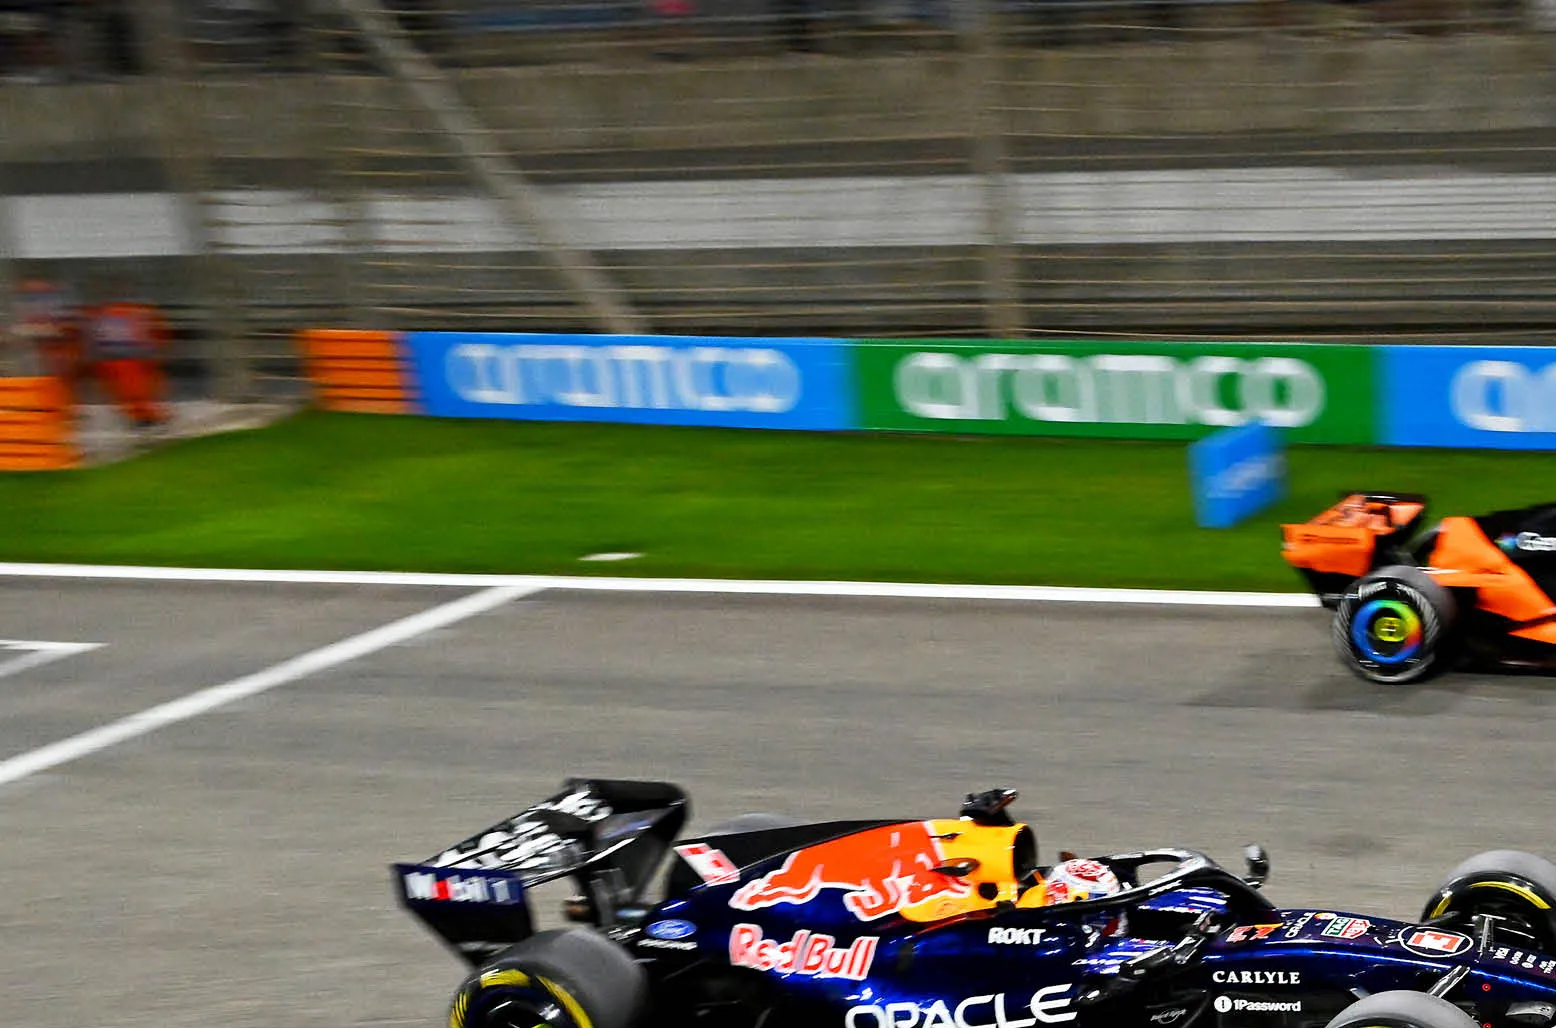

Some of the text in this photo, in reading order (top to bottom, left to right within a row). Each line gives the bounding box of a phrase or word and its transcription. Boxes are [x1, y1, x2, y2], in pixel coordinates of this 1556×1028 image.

[444, 342, 803, 413] aramco
[893, 350, 1328, 428] aramco
[729, 923, 880, 980] Red Bull
[988, 927, 1045, 945] ROKT
[1212, 970, 1300, 984] CARLYLE
[1233, 998, 1301, 1012] 1Password
